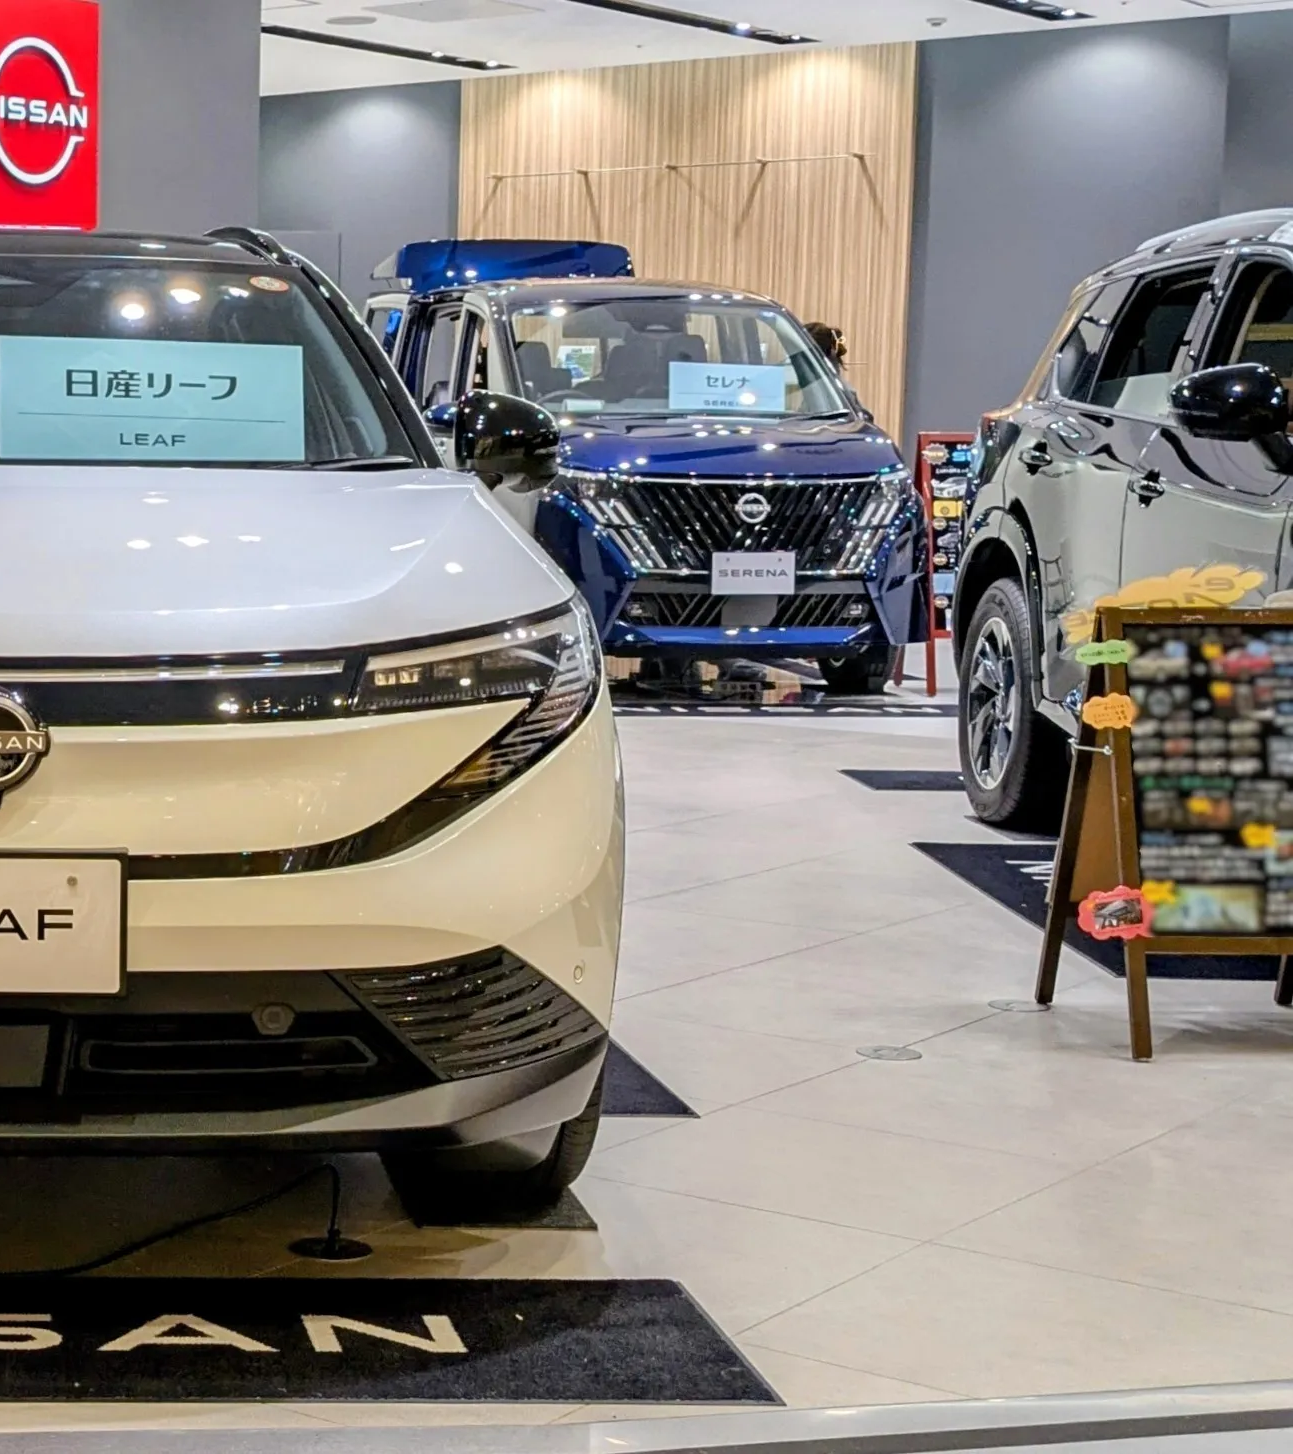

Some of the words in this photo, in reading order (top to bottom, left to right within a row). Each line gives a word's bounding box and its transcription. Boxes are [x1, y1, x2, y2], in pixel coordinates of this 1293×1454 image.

[65, 368, 238, 400] 日産リーフ
[705, 375, 751, 389] セレナ
[119, 432, 187, 447] LEAF
[718, 568, 789, 578] SERENA
